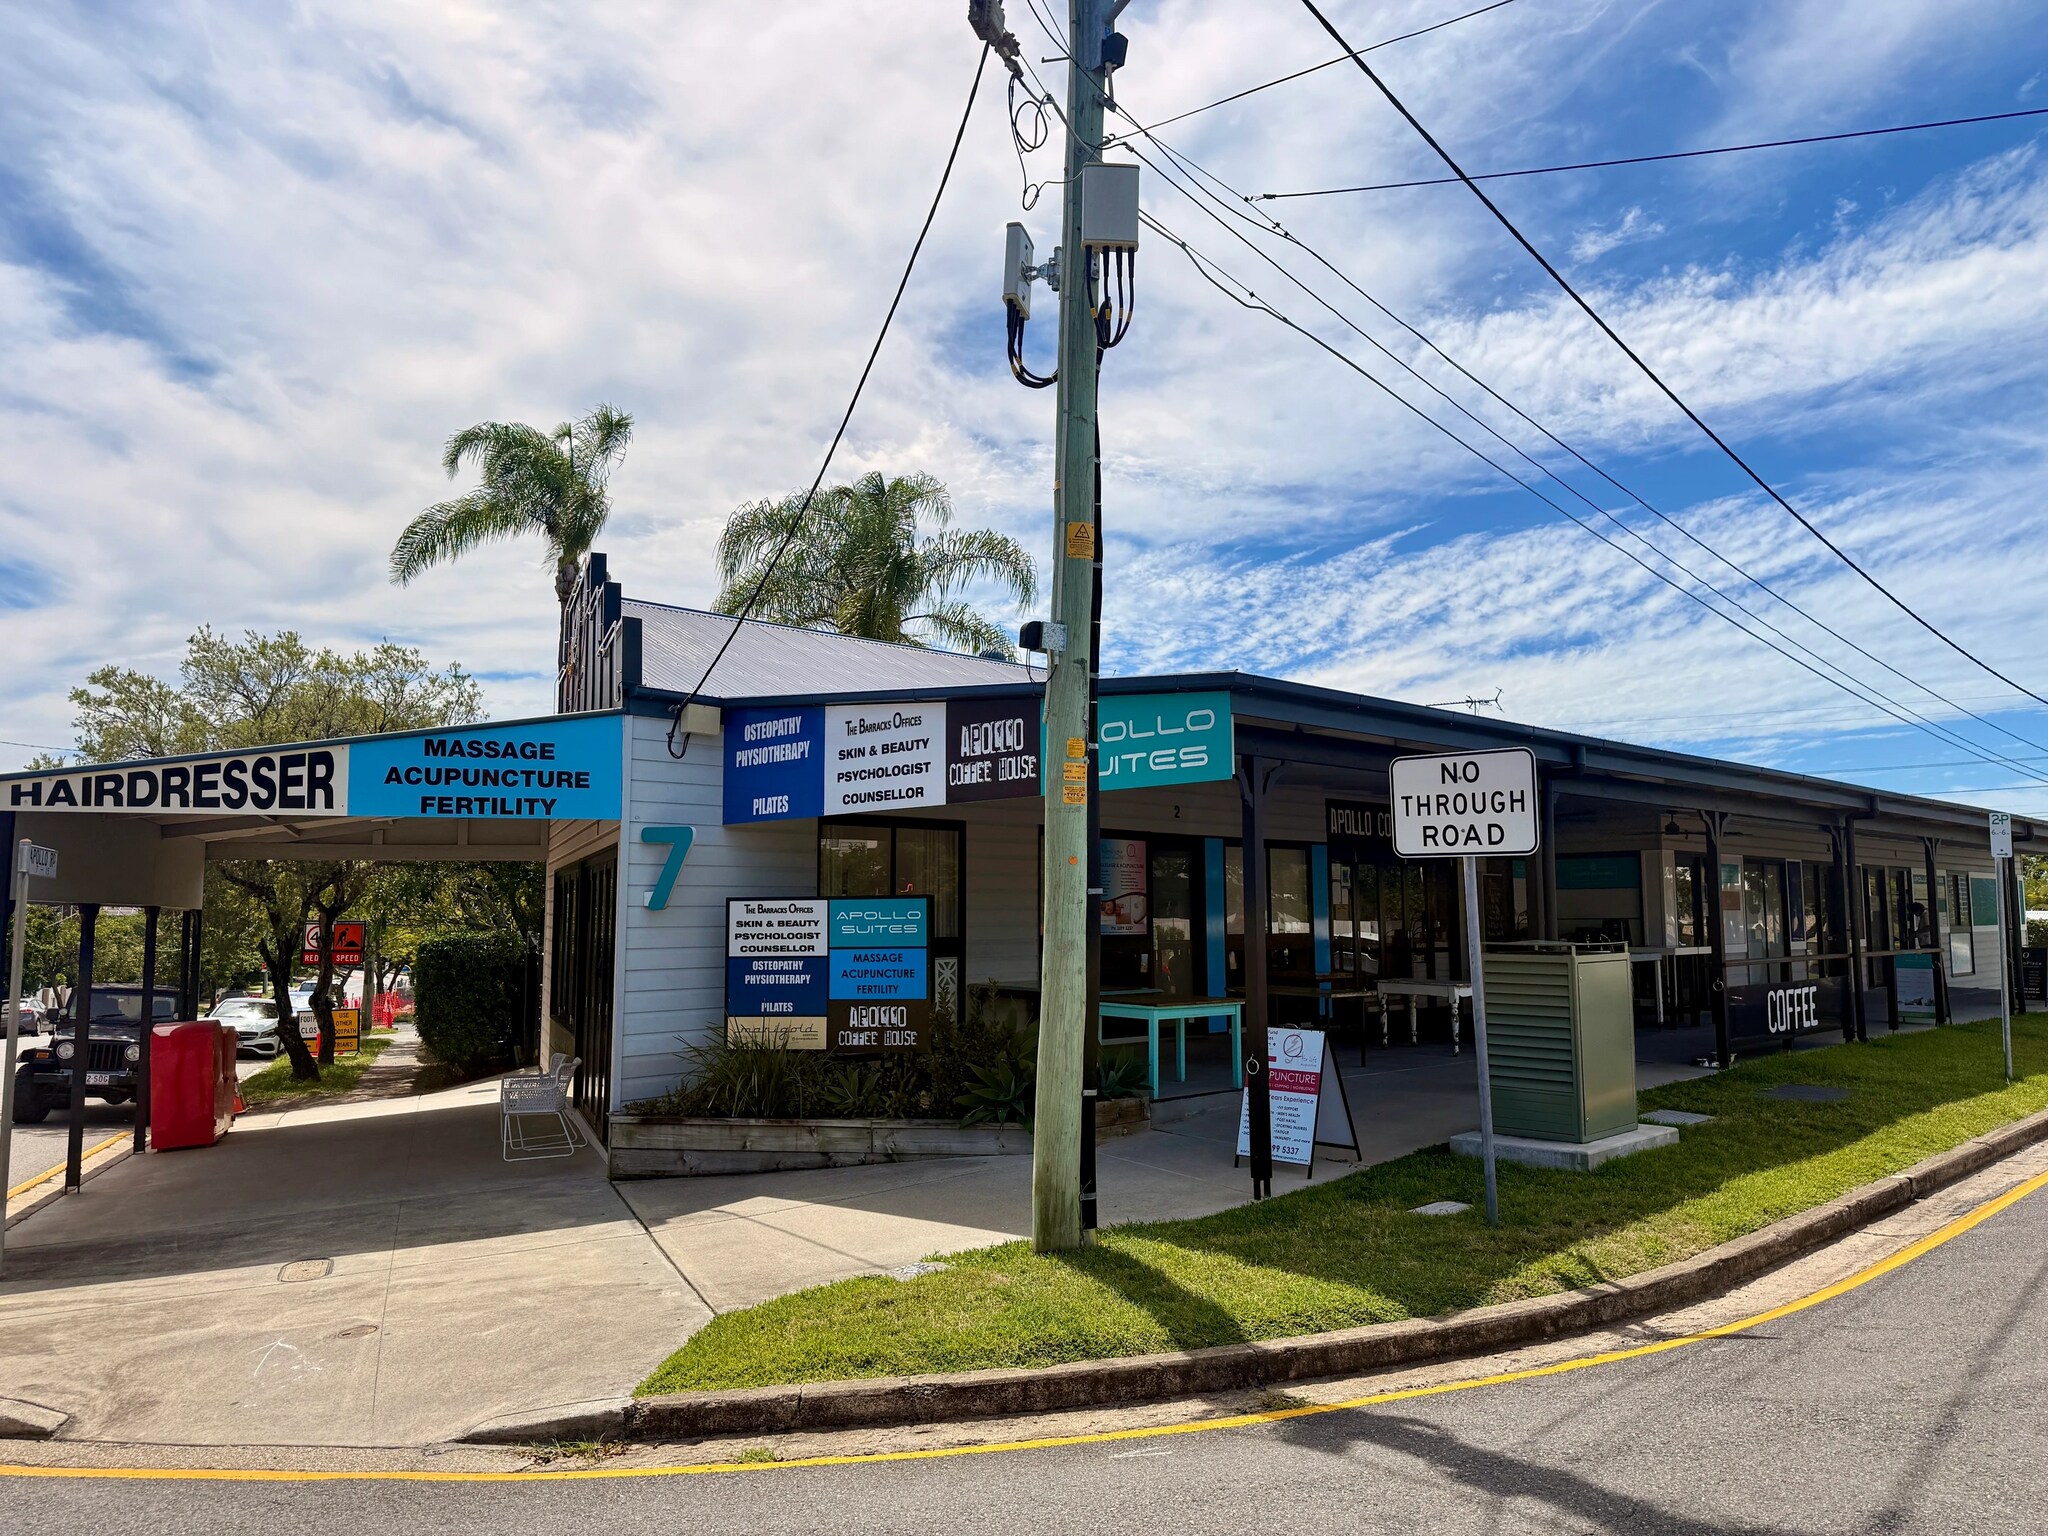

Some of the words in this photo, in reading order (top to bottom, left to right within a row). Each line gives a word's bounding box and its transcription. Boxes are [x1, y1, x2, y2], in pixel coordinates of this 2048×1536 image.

[744, 716, 802, 742] OSTEOPATHY
[859, 717, 892, 735] BARRACKS
[893, 712, 922, 729] OFFICES
[1100, 709, 1215, 742] OLLO
[960, 718, 1024, 757] APOLLO
[424, 739, 555, 760] MASSAGE
[736, 740, 810, 768] PHYSIOTHERAPY
[838, 745, 866, 761] SKIN
[869, 745, 878, 757] &
[881, 738, 930, 755] BEAUTY
[1099, 745, 1208, 776] UITES
[384, 767, 590, 789] ACUPUNCTURE
[837, 762, 931, 783] PSYCHOLOGIST
[949, 760, 992, 786] COFFEE
[998, 755, 1037, 781] HOUSE
[1441, 761, 1480, 784] NO
[10, 751, 335, 810] HAIRDRESSER
[842, 786, 924, 805] COUNSELLOR
[1401, 790, 1526, 817] THROUGH
[420, 796, 557, 816] FERTILITY
[752, 795, 789, 816] PILATES
[1174, 805, 1181, 818] 2
[1330, 807, 1371, 836] APOLLO
[1991, 814, 2009, 825] 2P
[1423, 823, 1505, 847] ROAD
[641, 826, 695, 911] 7
[757, 905, 787, 914] BARRACKS
[788, 904, 813, 914] OFFICES
[836, 911, 922, 920] APOLLO
[736, 920, 763, 928] SKIN
[766, 920, 774, 928] &
[841, 924, 918, 934] SUITES
[310, 932, 320, 943] 4
[735, 932, 821, 940] PSYCHOLOGIST
[336, 954, 359, 962] SPEED
[740, 944, 815, 953] COUNSELLOR
[853, 953, 903, 963] MASSAGE
[752, 961, 804, 970] OSTEOPATHY
[841, 969, 915, 978] ACUPUNCTURE
[745, 975, 811, 984] PHYSIOTHERAPY
[856, 985, 899, 994] FERTILITY
[761, 1002, 793, 1012] PILATES
[850, 1006, 907, 1027] APOLLO
[1767, 985, 1819, 1033] COFFEE
[838, 1031, 878, 1046] COFFEE
[884, 1031, 917, 1046] HOUSE
[1269, 1071, 1316, 1084] PUNCTURE
[1284, 1095, 1314, 1105] Experience
[1272, 1144, 1281, 1152] 99
[1282, 1145, 1300, 1156] 5337
